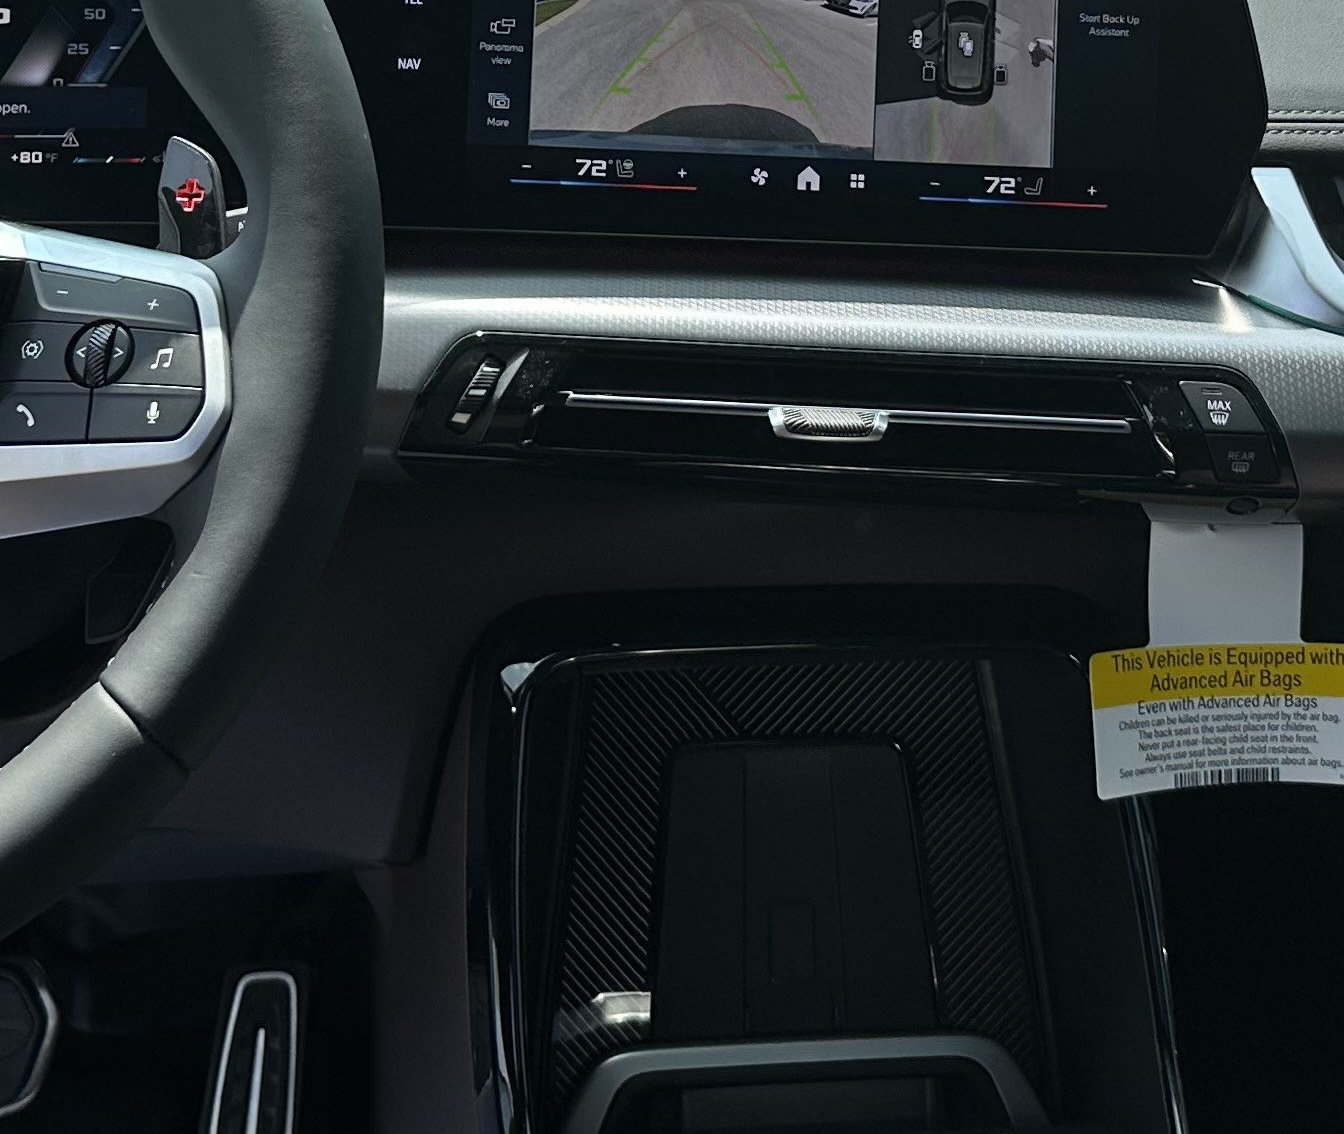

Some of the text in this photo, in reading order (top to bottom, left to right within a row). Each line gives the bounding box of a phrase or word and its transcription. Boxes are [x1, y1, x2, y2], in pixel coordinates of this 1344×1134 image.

[84, 8, 106, 20] 50
[1079, 12, 1140, 26] Start Back Up
[1088, 26, 1130, 38] Assistant
[67, 43, 89, 55] 25
[479, 41, 524, 53] Panorama
[397, 57, 422, 71] NAV
[491, 55, 512, 66] view
[486, 116, 510, 128] More
[10, 151, 43, 164] +80
[1207, 399, 1232, 412] MAX
[1227, 450, 1256, 462] REAR
[1111, 652, 1144, 673] This
[1145, 648, 1205, 669] Vehicle
[1209, 647, 1222, 665] is
[1226, 646, 1306, 669] Equipped
[1149, 668, 1303, 692] Advanced Air Bags
[1137, 693, 1318, 716] Even with Advanced Air Bags
[1118, 711, 1341, 732] Children can be killed or seriously injured by the air bag.
[1138, 729, 1153, 740] The
[1153, 727, 1173, 739] back
[1173, 726, 1191, 737] seat
[1201, 724, 1214, 734] the
[1215, 723, 1242, 733] safest
[1242, 723, 1266, 734] place
[1267, 722, 1279, 732] for
[1280, 722, 1319, 733] children.
[1138, 741, 1161, 753] Never
[1161, 739, 1177, 752] put
[1228, 734, 1249, 744] child
[1249, 734, 1269, 744] seat
[1279, 734, 1295, 743] the
[1144, 751, 1172, 764] Always
[1172, 750, 1187, 759] use
[1188, 747, 1206, 758] seat
[1206, 746, 1228, 757] belts
[1228, 745, 1245, 755] and
[1245, 745, 1267, 755] child
[1119, 768, 1134, 779] See
[1164, 761, 1194, 773] manual
[1195, 759, 1207, 769] for
[1207, 758, 1229, 768] more
[1230, 756, 1279, 767] information
[1280, 756, 1307, 767] about
